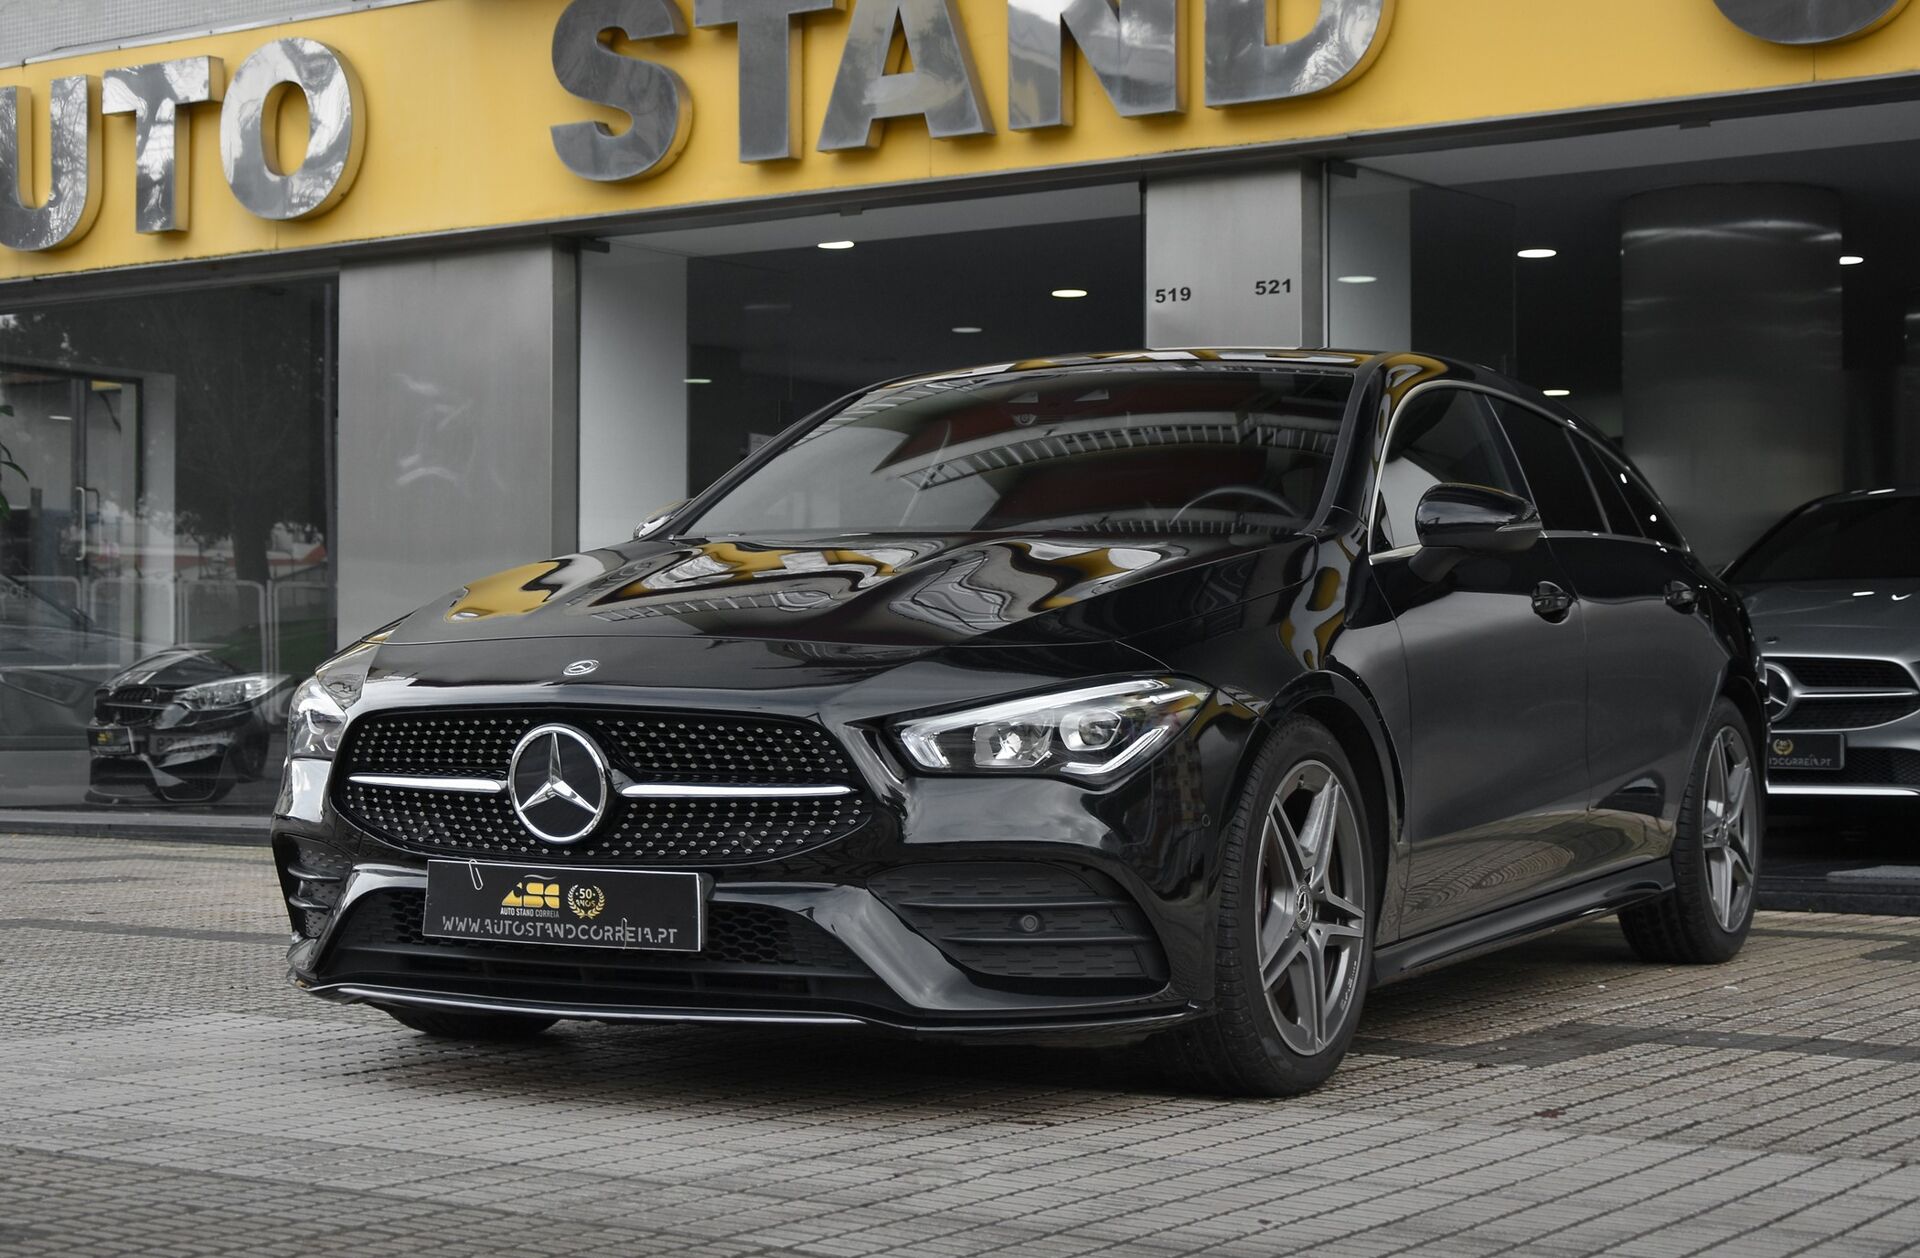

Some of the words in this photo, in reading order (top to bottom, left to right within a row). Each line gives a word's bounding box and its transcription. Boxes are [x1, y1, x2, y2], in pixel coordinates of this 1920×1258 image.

[550, 0, 1394, 183] STAND
[1155, 286, 1192, 304] 519
[1254, 278, 1292, 296] 521
[579, 888, 593, 899] 50
[500, 907, 515, 916] AUTO
[516, 908, 534, 917] STAND
[535, 909, 560, 918] CORREIA
[442, 915, 678, 944] WWW.AUTOSTANDCORREIA.PT
